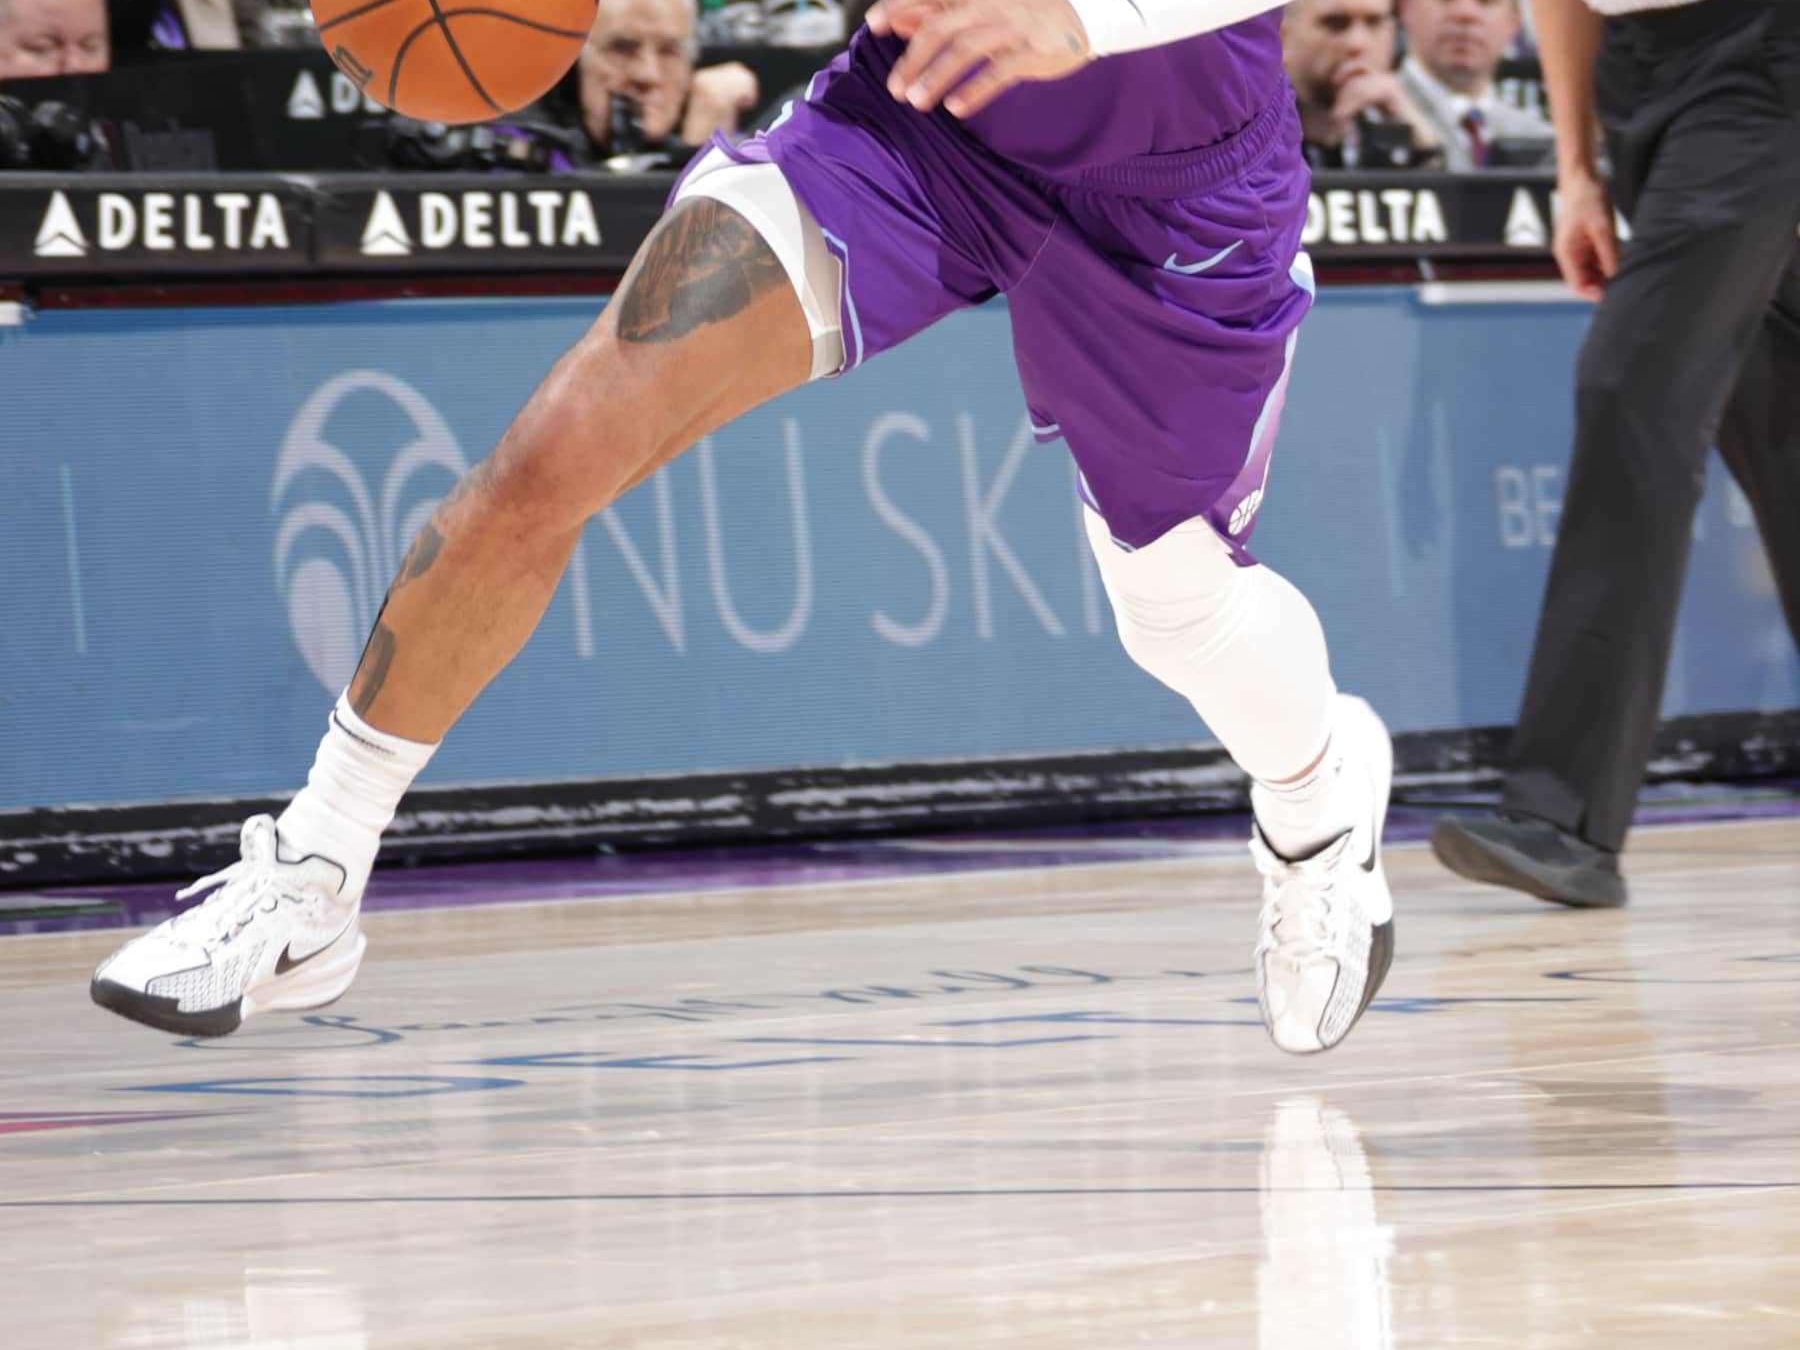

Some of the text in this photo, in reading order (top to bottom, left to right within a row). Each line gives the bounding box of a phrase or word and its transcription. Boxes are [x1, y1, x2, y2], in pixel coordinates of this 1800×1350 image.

[100, 192, 289, 249] DELTA
[419, 191, 601, 247] DELTA
[1300, 189, 1448, 244] DELTA
[573, 410, 1102, 657] NU SKI
